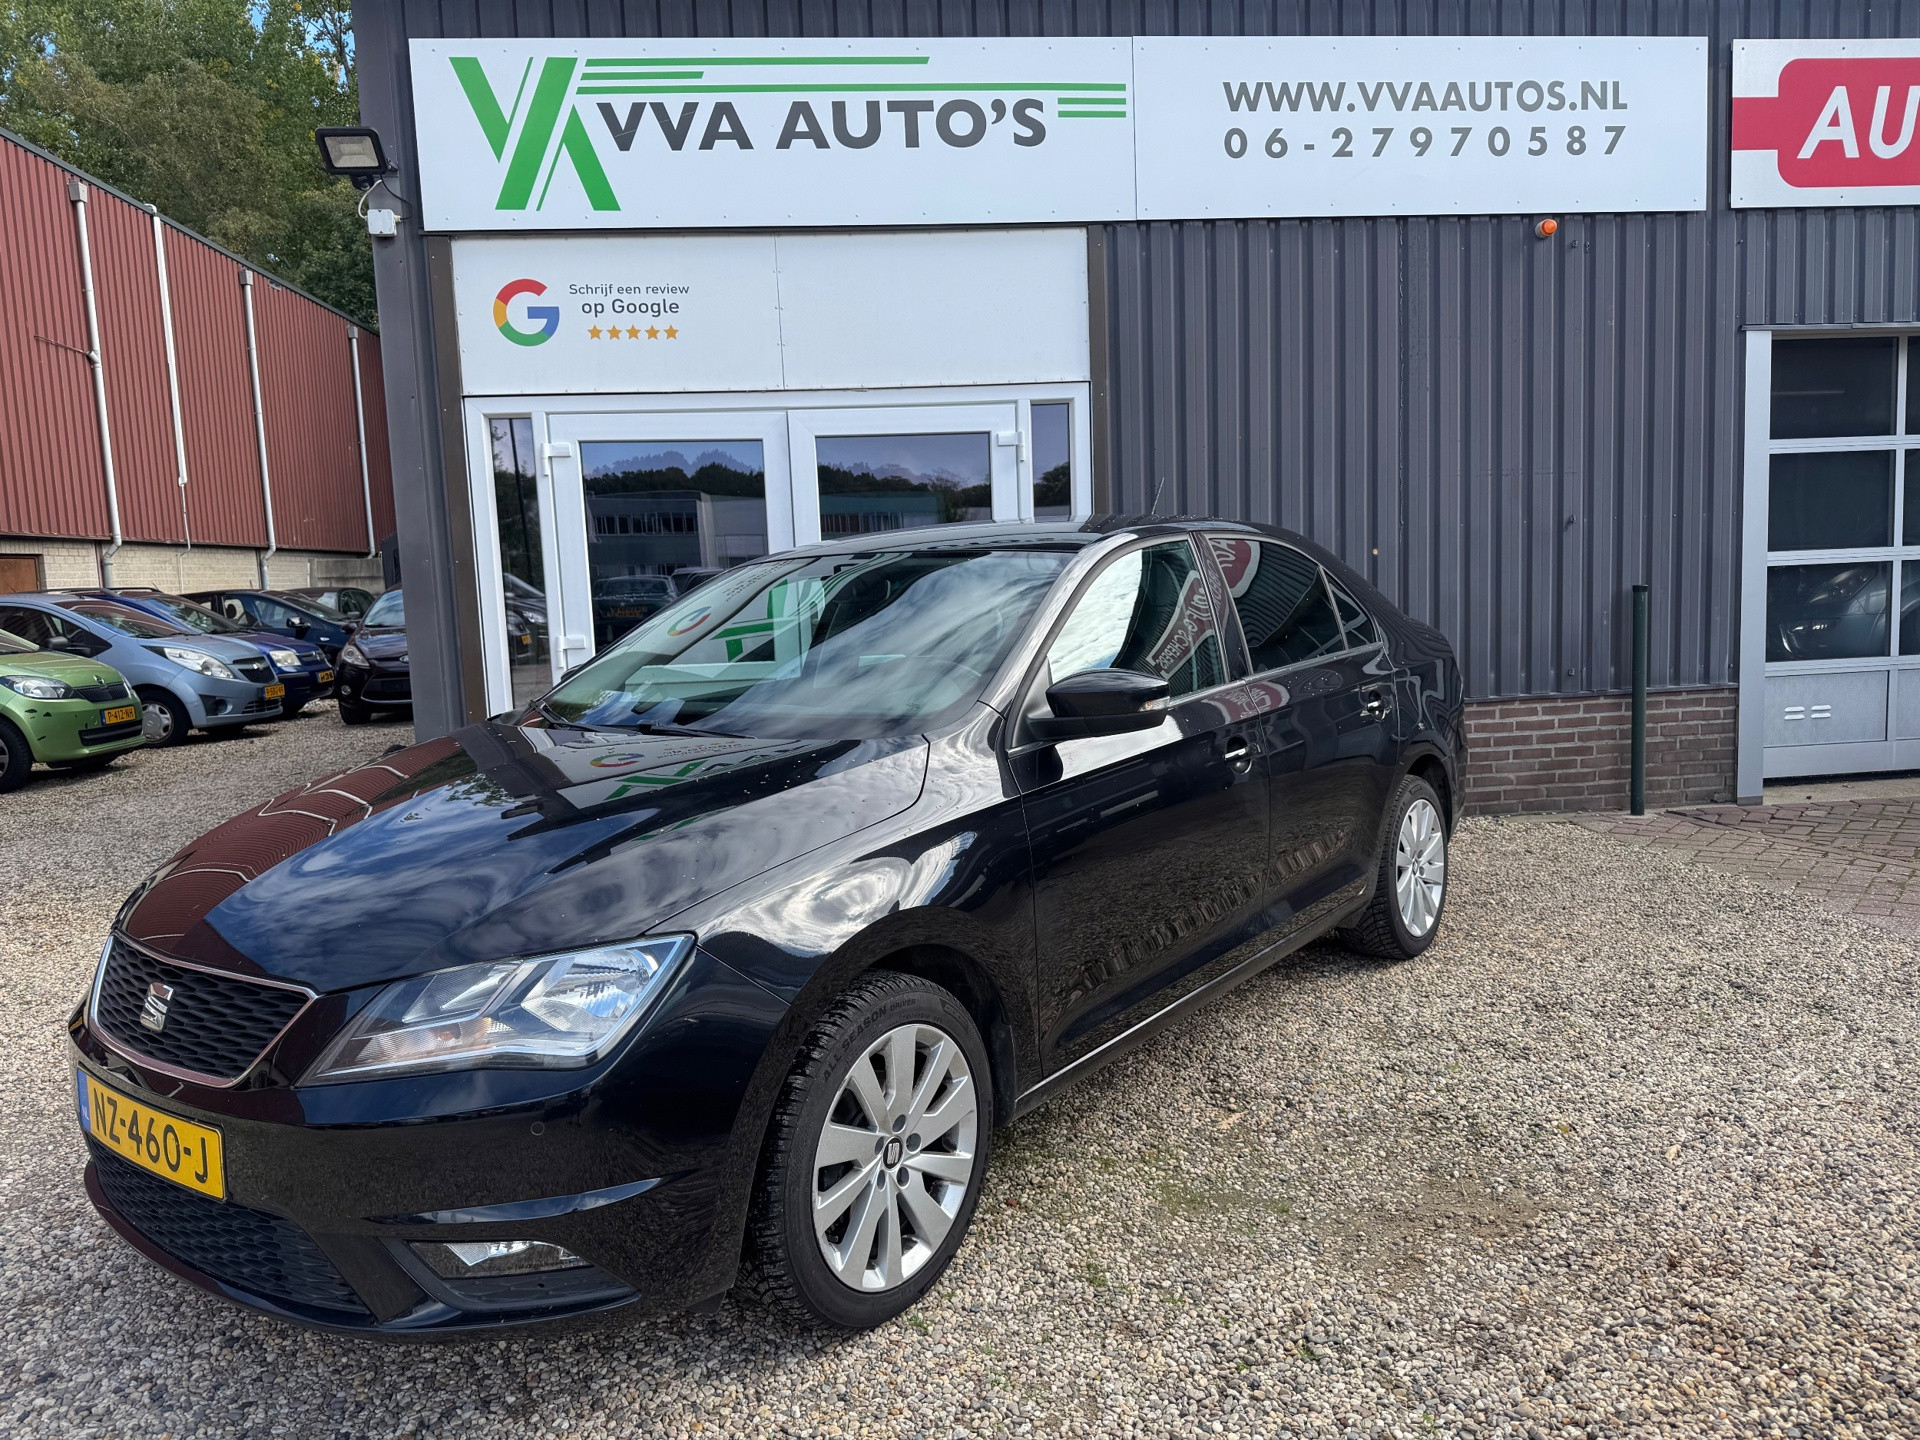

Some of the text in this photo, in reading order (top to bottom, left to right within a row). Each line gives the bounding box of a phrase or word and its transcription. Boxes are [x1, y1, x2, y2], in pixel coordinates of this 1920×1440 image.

[1222, 80, 1628, 112] WWW.VVAAUTOS.NL
[596, 98, 1047, 152] VVA AUTO'S
[1224, 125, 1627, 159] 06-27970587
[1797, 85, 1920, 159] AU
[569, 283, 690, 297] Schrijf een review
[581, 298, 680, 318] op Google
[823, 1053, 842, 1082] ALL
[841, 1005, 887, 1052] SEASON
[890, 998, 917, 1012] DRIVER
[93, 1087, 209, 1184] NZ-460-J
